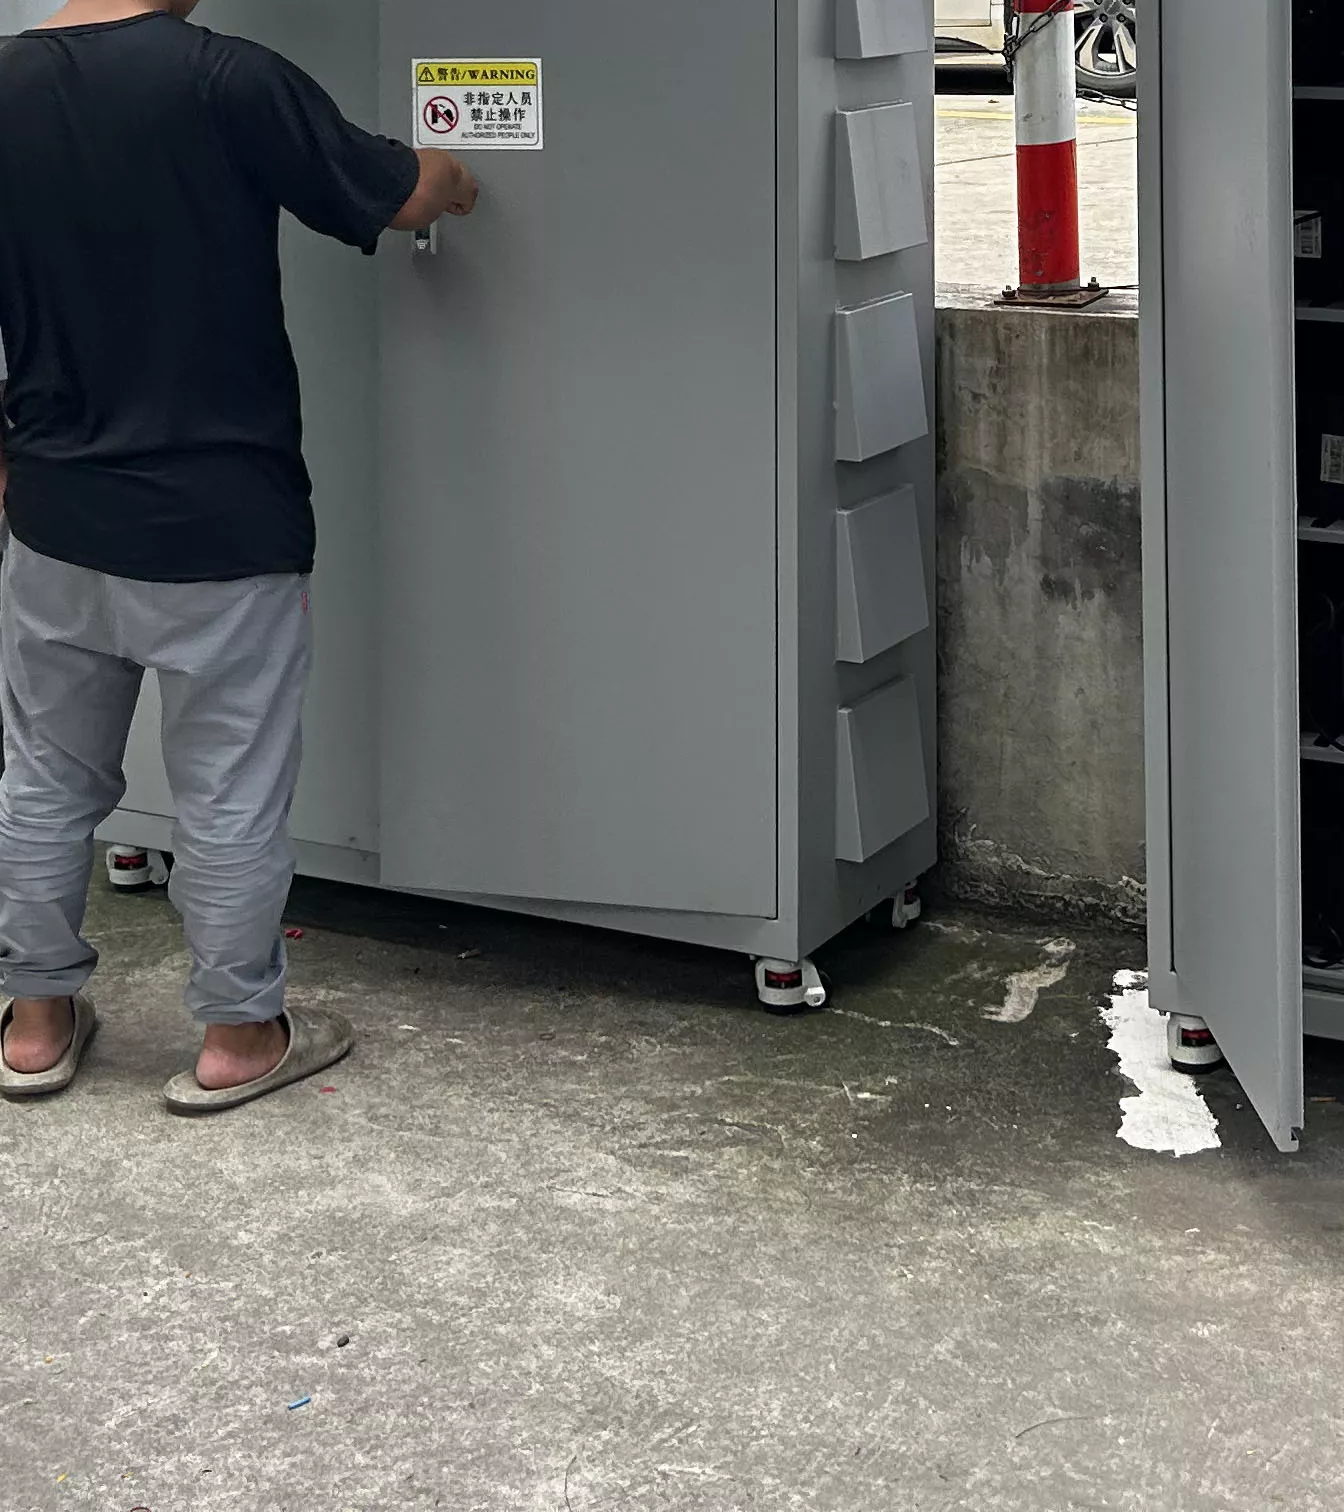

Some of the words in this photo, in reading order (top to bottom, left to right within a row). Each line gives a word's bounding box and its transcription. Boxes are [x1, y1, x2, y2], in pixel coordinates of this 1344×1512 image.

[463, 92, 532, 106] 非指定人员
[470, 107, 526, 122] 禁止操作
